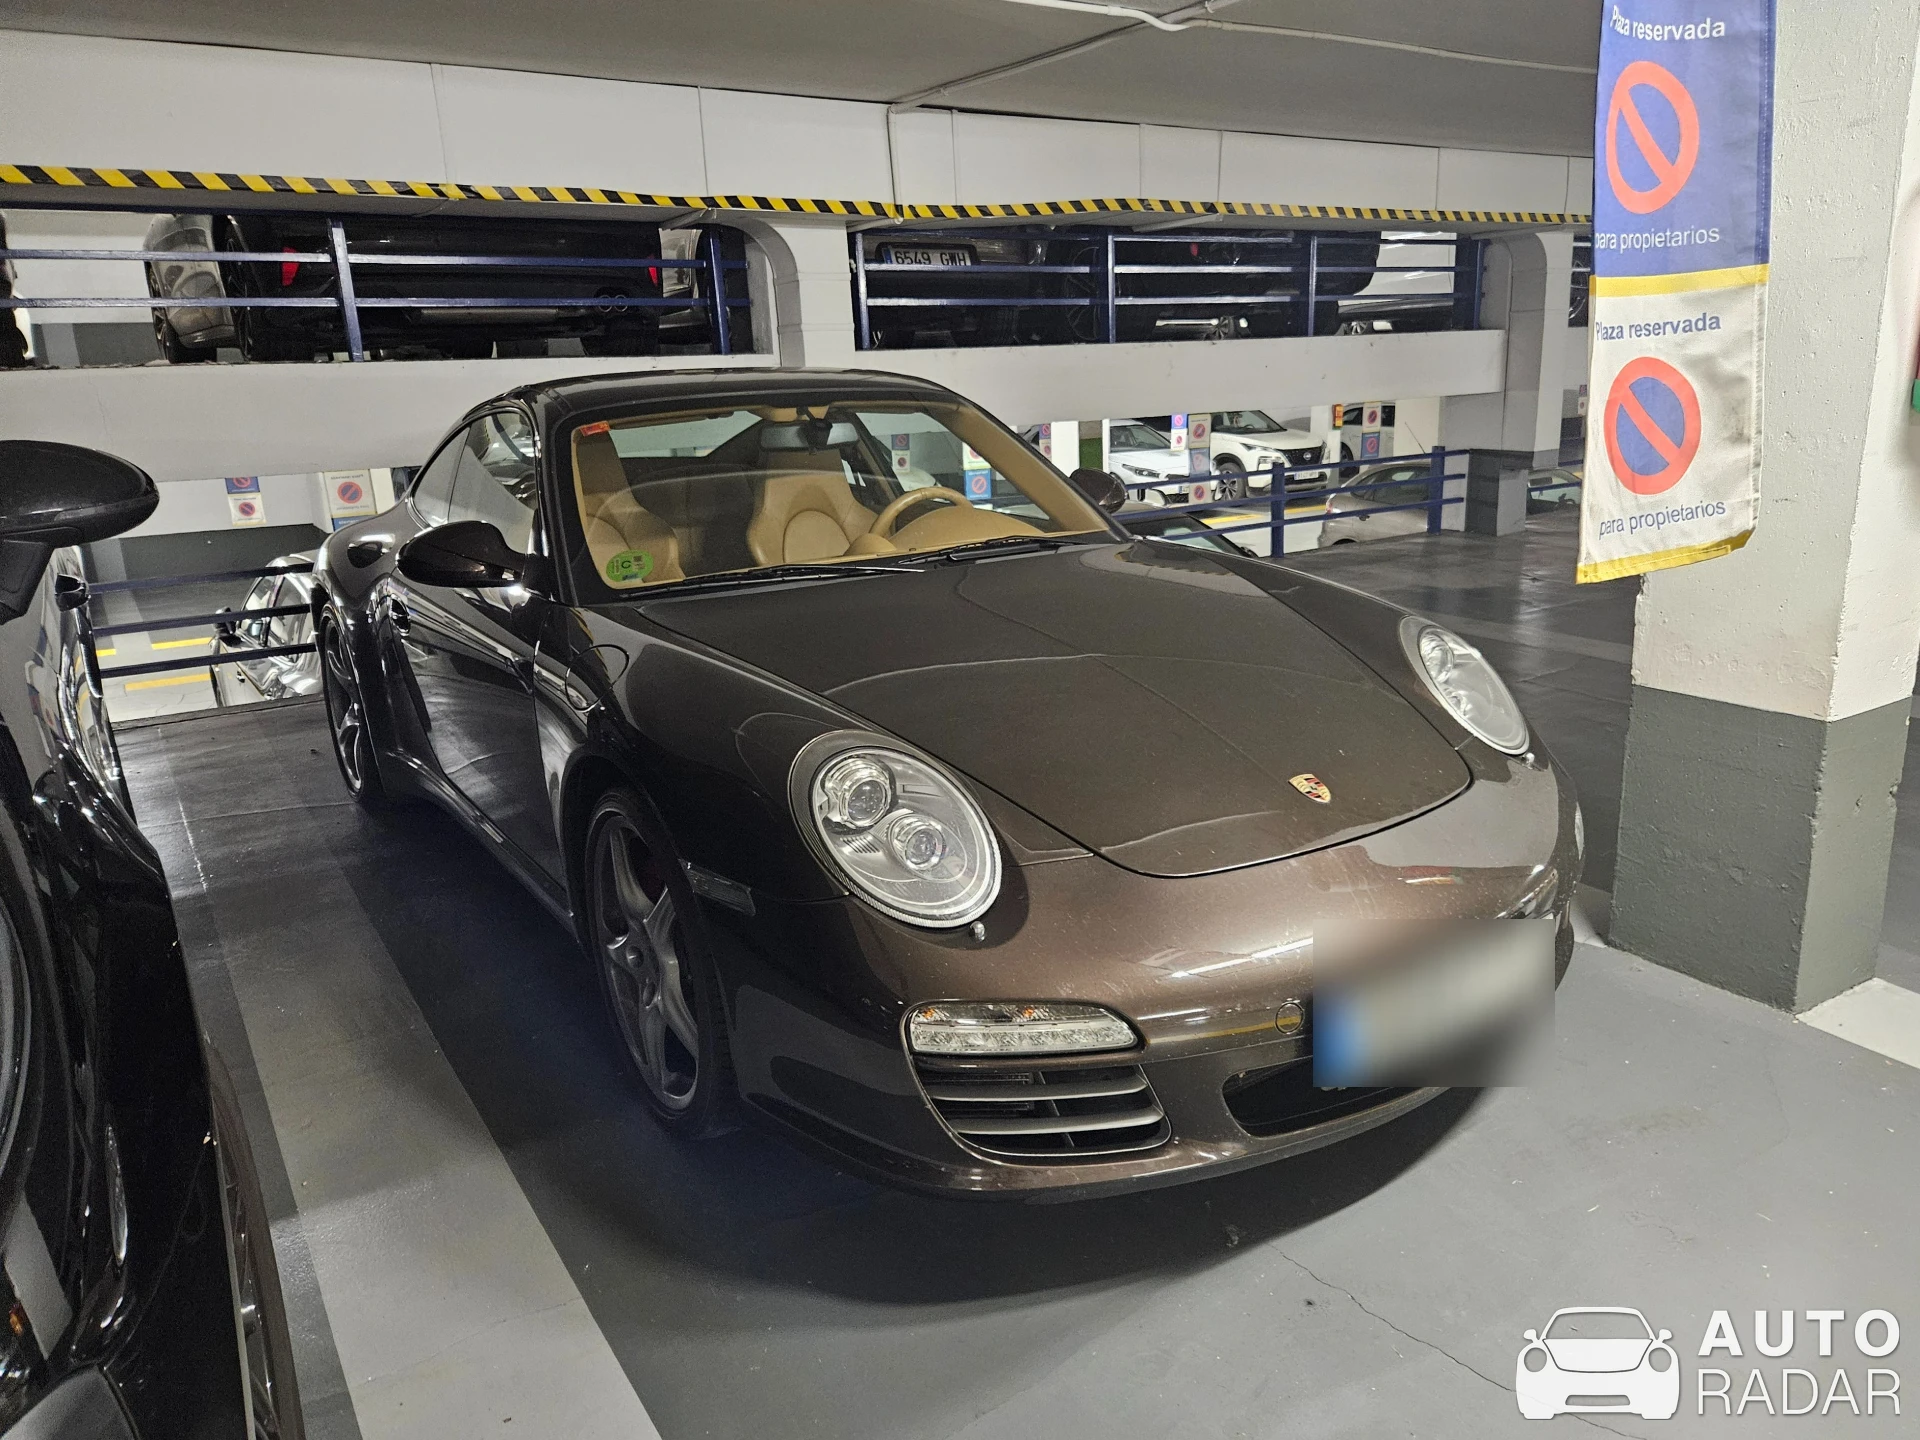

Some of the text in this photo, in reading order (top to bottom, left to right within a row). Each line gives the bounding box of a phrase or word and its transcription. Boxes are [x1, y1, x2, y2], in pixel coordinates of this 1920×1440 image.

[1609, 4, 1726, 41] Plaza reservada
[1620, 225, 1720, 254] propietarios
[894, 250, 968, 266] 6549 GWH
[1595, 312, 1721, 341] Plaza reservada
[1599, 500, 1726, 540] para propietarios
